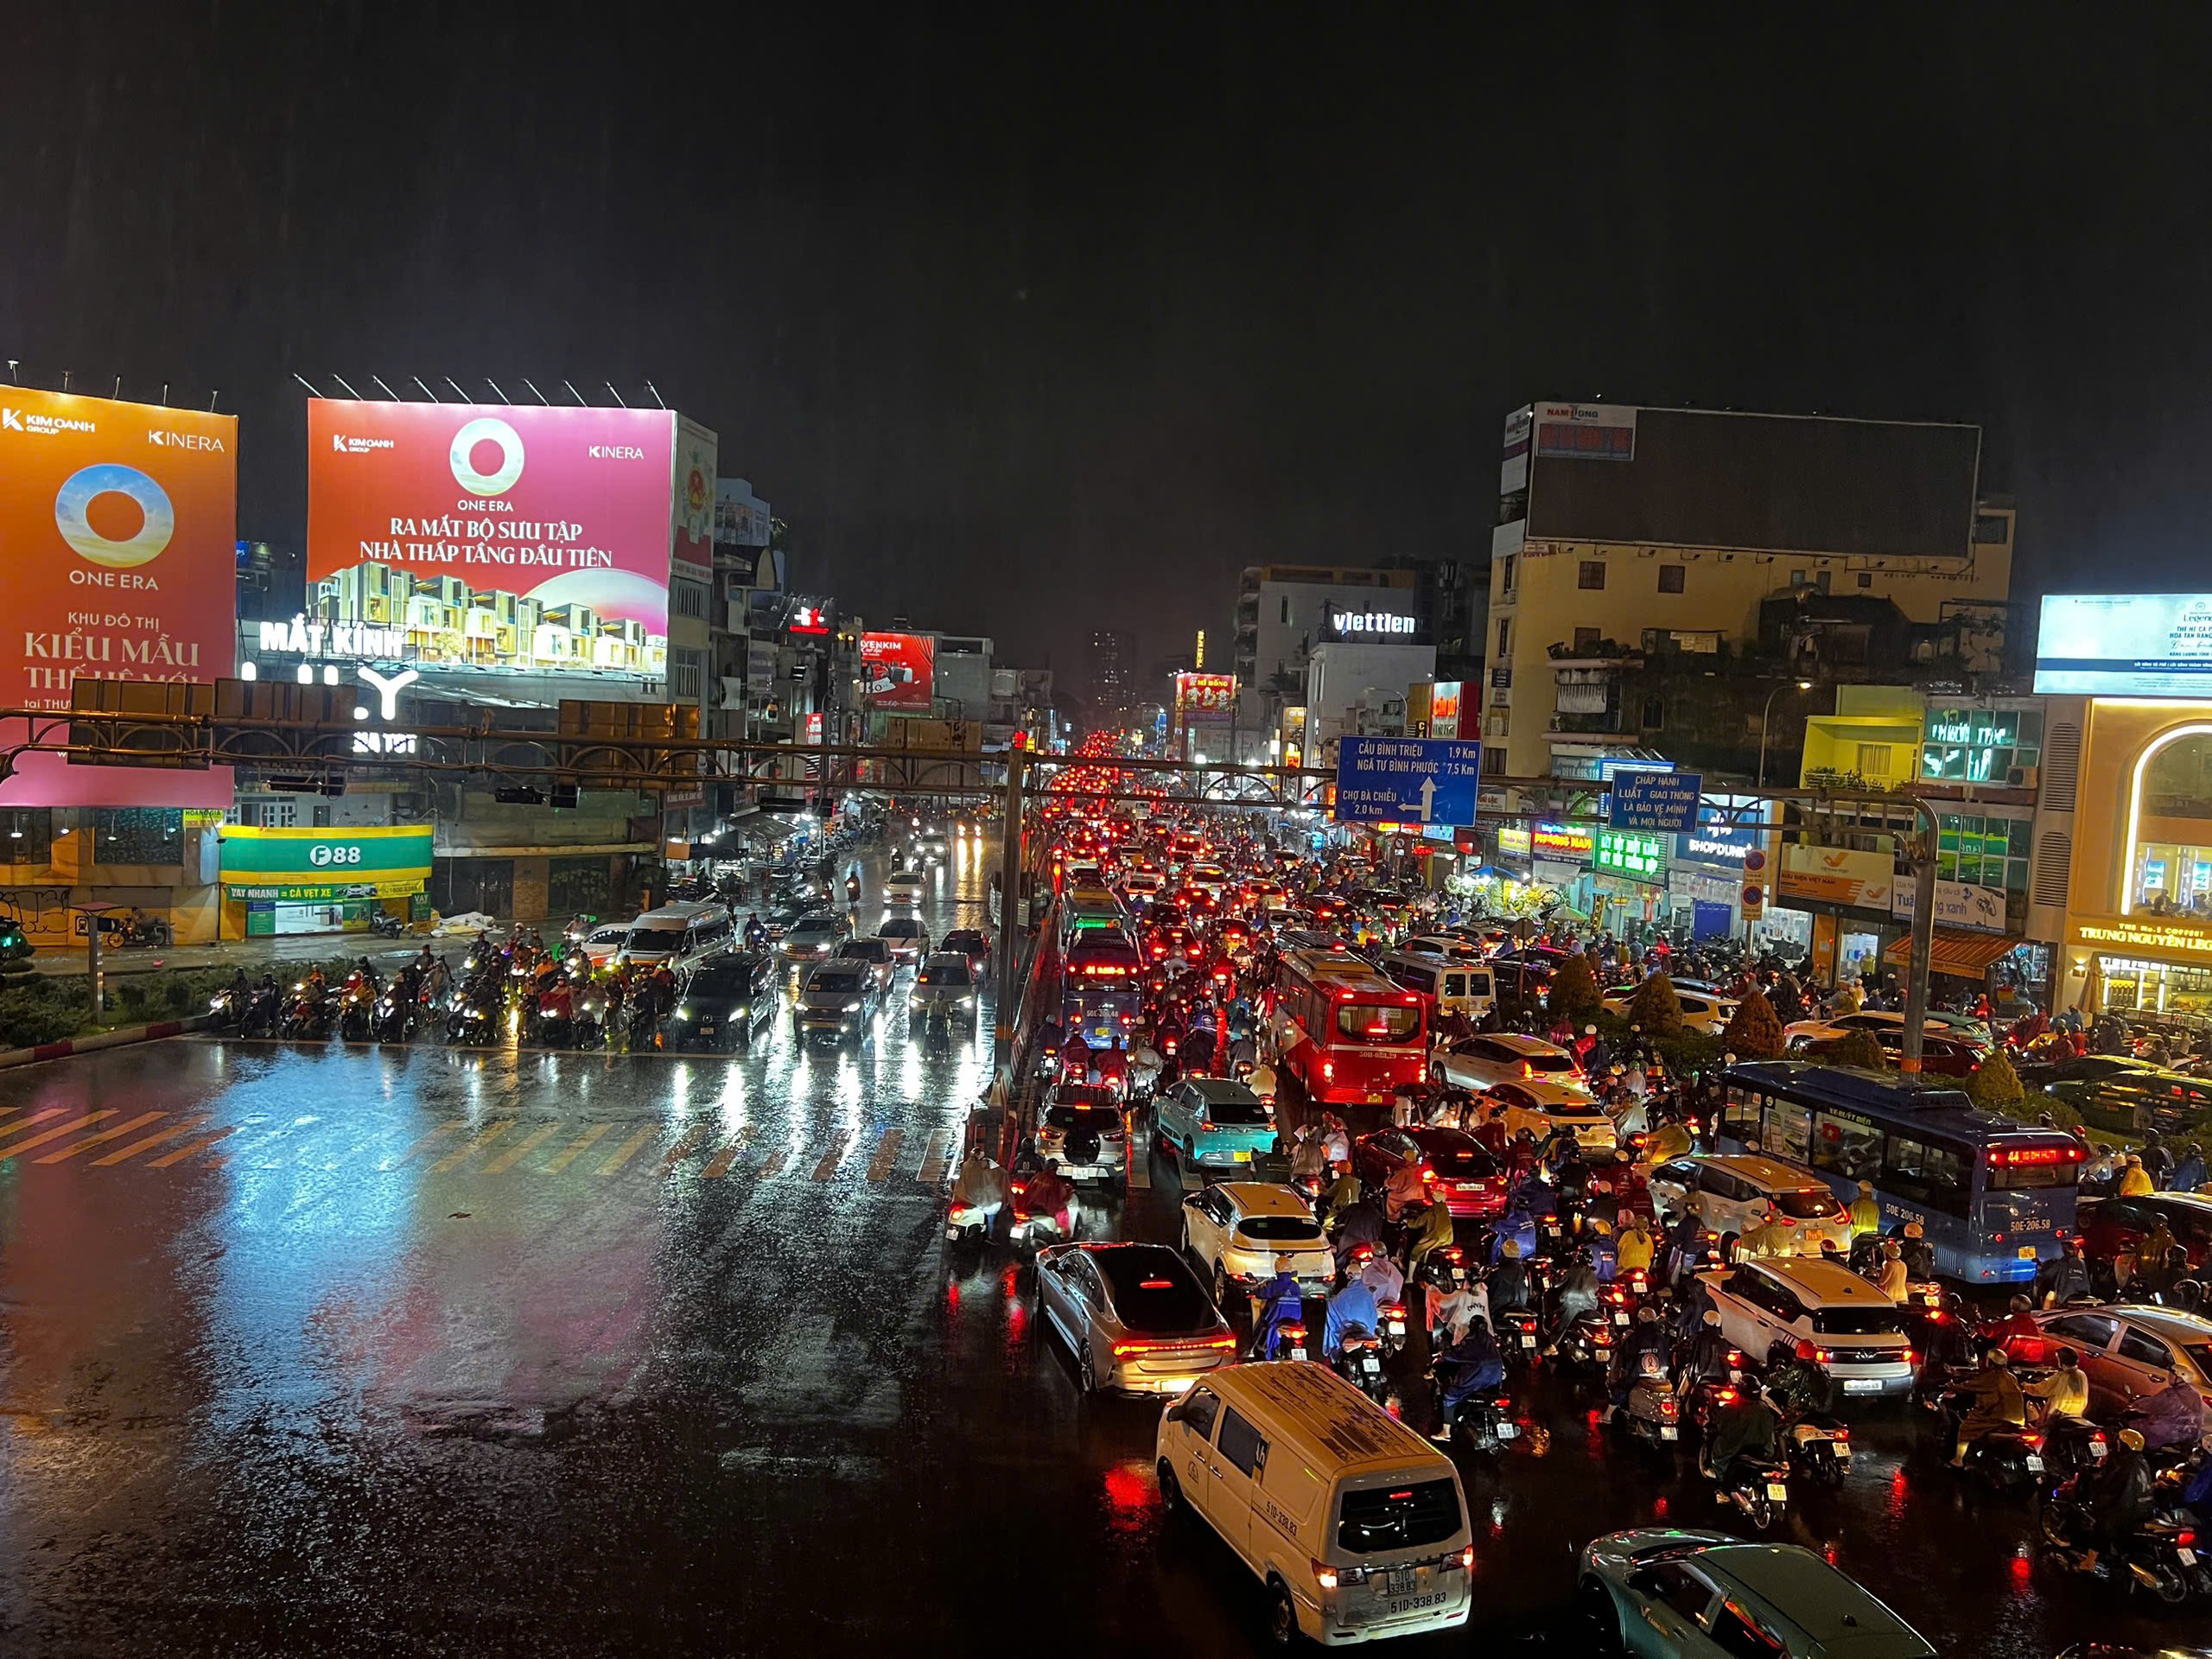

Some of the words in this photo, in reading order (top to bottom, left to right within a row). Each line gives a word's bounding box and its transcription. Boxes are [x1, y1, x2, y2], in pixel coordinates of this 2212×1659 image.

[1547, 408, 1569, 416] NAM
[27, 415, 52, 426] KIM
[54, 418, 95, 432] OANH
[27, 426, 60, 435] GROUP
[149, 429, 225, 453] KINERA
[348, 438, 366, 447] KIM
[366, 439, 393, 448] OANH
[589, 445, 644, 460] KINERA
[457, 499, 486, 511] ONE
[489, 500, 513, 512] ERA
[391, 517, 417, 536] RA
[421, 514, 462, 537] MẮT
[467, 518, 494, 542] BỘ
[498, 520, 541, 540] SƯU
[544, 520, 583, 543] TẬP
[359, 540, 403, 560] NHÀ
[406, 540, 459, 562] THẤP
[461, 542, 515, 563] TẦNG
[519, 543, 563, 566] ĐẦU
[566, 546, 613, 568] TIÊN
[69, 569, 114, 588] ONE
[120, 575, 159, 591] ERA
[68, 611, 100, 626] KHU
[105, 613, 131, 628] ĐÔ
[135, 616, 160, 632] THỊ
[1334, 612, 1415, 635] viettien
[260, 613, 325, 653] MẮT
[333, 620, 404, 658] KÍNH
[24, 627, 111, 662] KIỂU
[122, 633, 200, 667] MẪU
[1358, 739, 1375, 755] CẦU
[1377, 741, 1396, 756] BÌNH
[1399, 743, 1423, 758] TRIỆU
[1449, 747, 1460, 759] 1.9
[1463, 748, 1476, 760] Km
[1357, 759, 1374, 772] NGÃ
[1376, 760, 1389, 772] TƯ
[1389, 758, 1408, 772] BÌNH
[1411, 759, 1439, 773] PHƯỚC
[1461, 763, 1474, 775] Km
[1636, 774, 1656, 785] CHẤP
[1658, 775, 1679, 785] HÀNH
[1343, 790, 1359, 802] CHỢ
[1361, 789, 1371, 802] BÀ
[1619, 786, 1643, 799] LUẬT
[1650, 790, 1668, 799] GIAO
[1670, 791, 1694, 800] THÔNG
[1355, 804, 1366, 815] 2.0
[1369, 804, 1382, 815] km
[1624, 801, 1633, 811] LÀ
[1637, 801, 1651, 812] BẢO
[1655, 803, 1664, 813] VỆ
[1666, 803, 1687, 814] MÌNH
[1629, 815, 1637, 825] VÀ
[1641, 817, 1655, 829] MỌI
[1658, 817, 1681, 827] NGƯỜI
[309, 845, 361, 867] F88
[1689, 840, 1748, 858] SHOPDUNK
[232, 888, 245, 898] VAY
[247, 888, 278, 899] NHANH
[289, 887, 302, 898] CÀ
[303, 887, 320, 899] VẸT
[321, 887, 331, 897] XE
[415, 894, 429, 904] VAY
[1947, 903, 1967, 915] xanh
[2079, 926, 2126, 943] TRUNG
[2127, 931, 2185, 948] NGUYÊN
[2008, 1151, 2019, 1162] 44
[1391, 1592, 1446, 1614] 51D-338.83
